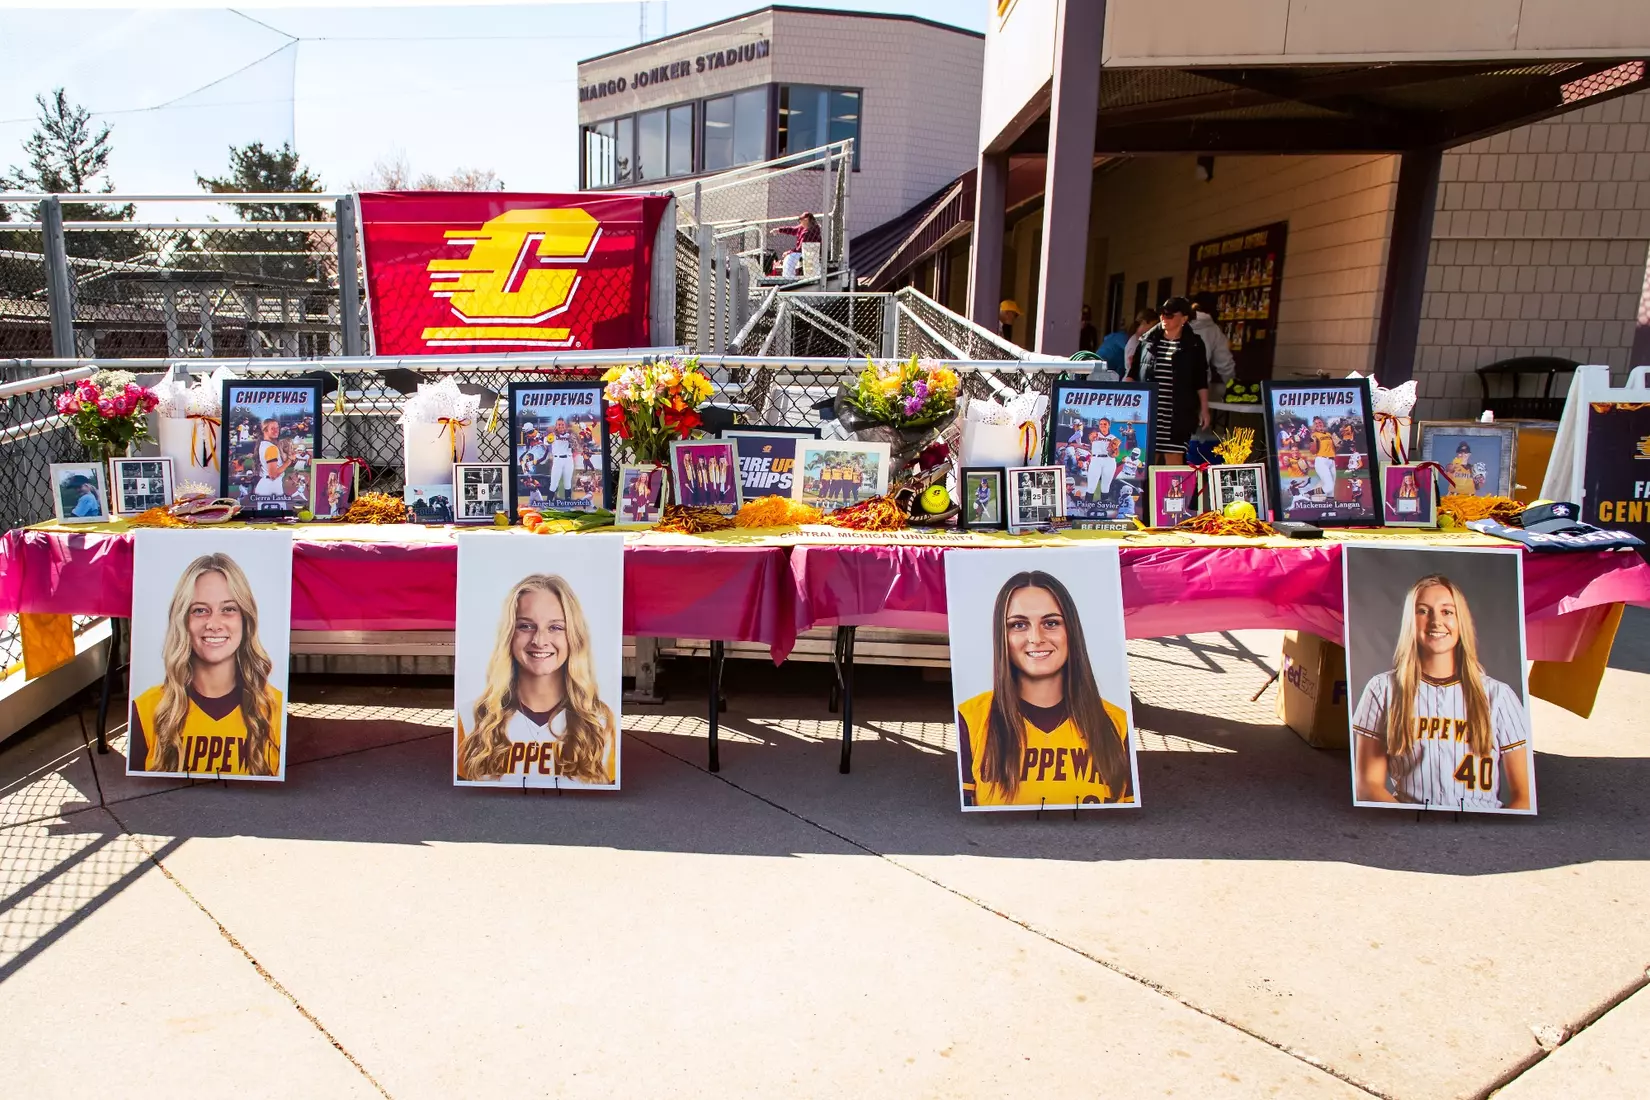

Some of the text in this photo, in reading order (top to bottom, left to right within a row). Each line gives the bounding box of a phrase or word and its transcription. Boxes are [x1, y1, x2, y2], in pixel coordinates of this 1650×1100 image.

[579, 39, 770, 103] MARGO JONKER STADIUM
[235, 390, 308, 404] CHIPPEWAS
[522, 392, 594, 406] CHIPPEWAS
[1065, 391, 1142, 407] CHIPPEWAS
[1279, 391, 1354, 406] CHIPPEWAS
[738, 456, 796, 472] FIRE UP
[740, 471, 793, 489] CHIPS
[1077, 500, 1096, 509] Paige
[1295, 500, 1361, 510] Mackenzie Langan
[1081, 523, 1128, 531] BE FIERCE
[780, 530, 833, 539] CENTRAL
[837, 531, 898, 540] MICHIGAN
[180, 735, 249, 773] IPPEW
[1453, 752, 1493, 792] 40
